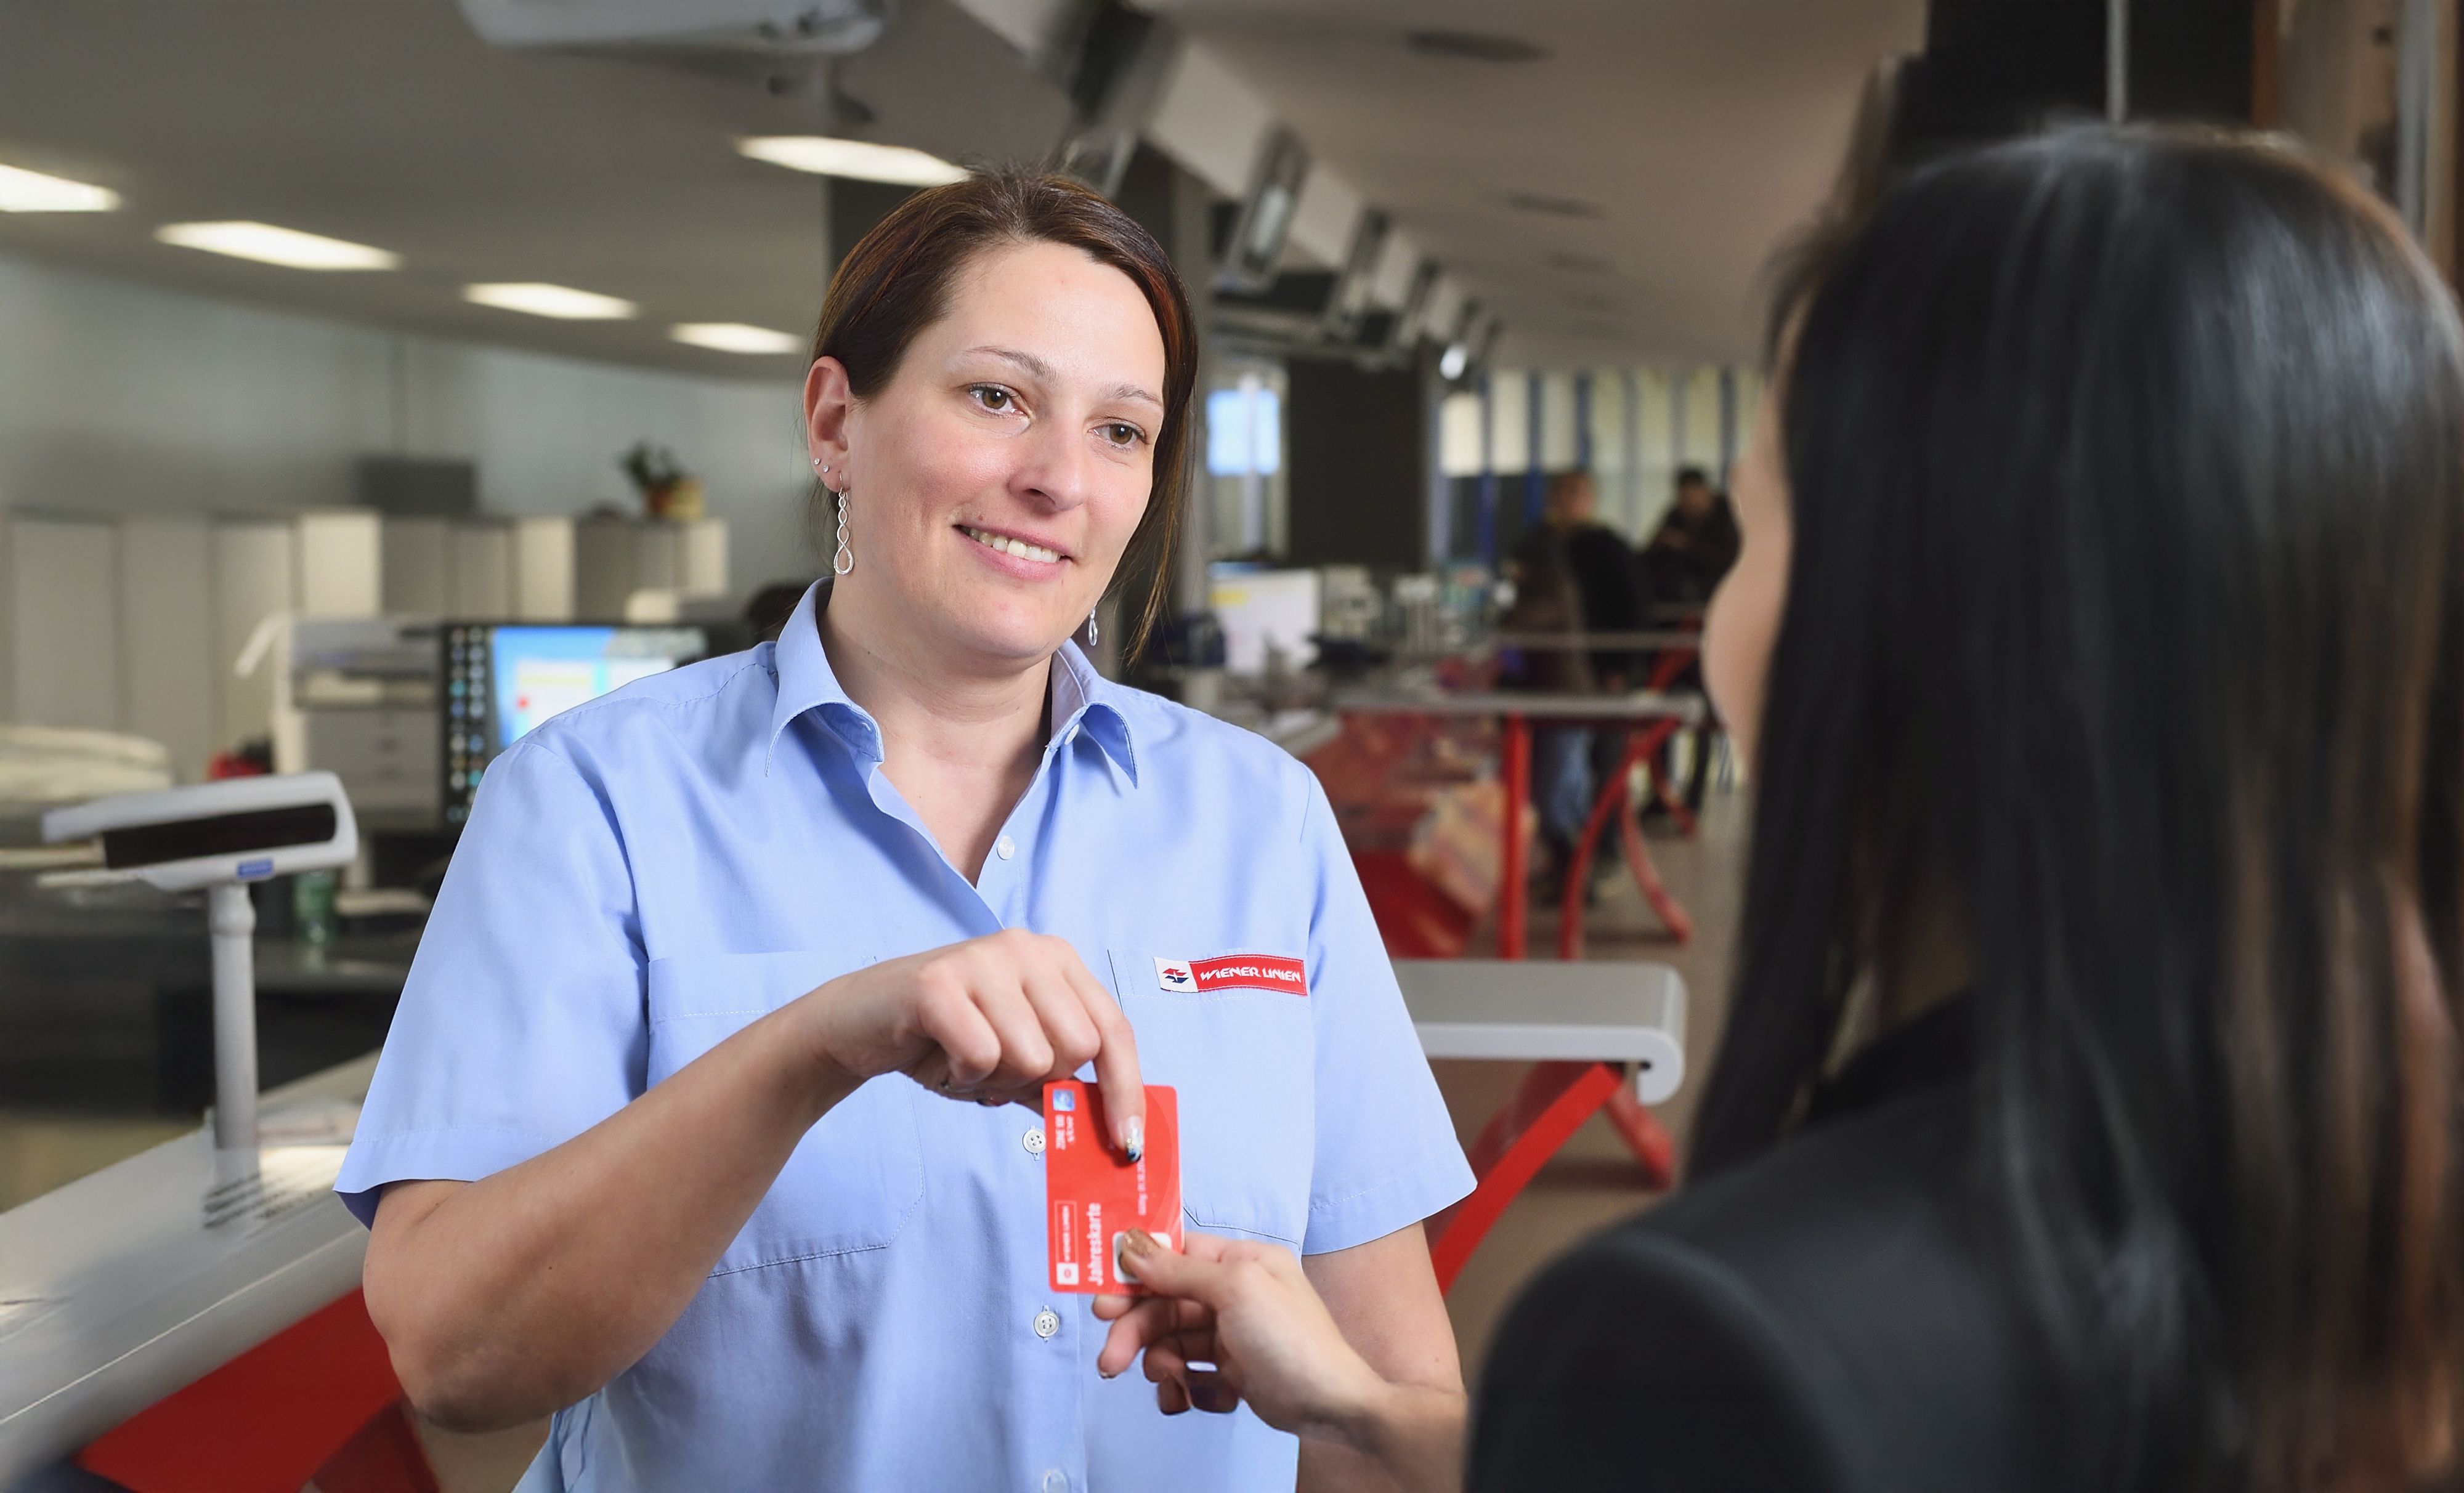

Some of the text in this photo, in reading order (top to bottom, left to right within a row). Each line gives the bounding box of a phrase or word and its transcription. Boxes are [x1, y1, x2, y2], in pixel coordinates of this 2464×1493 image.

[1200, 966, 1302, 984] WIENER LINIEN
[1086, 1202, 1104, 1287] Jahreskarte
